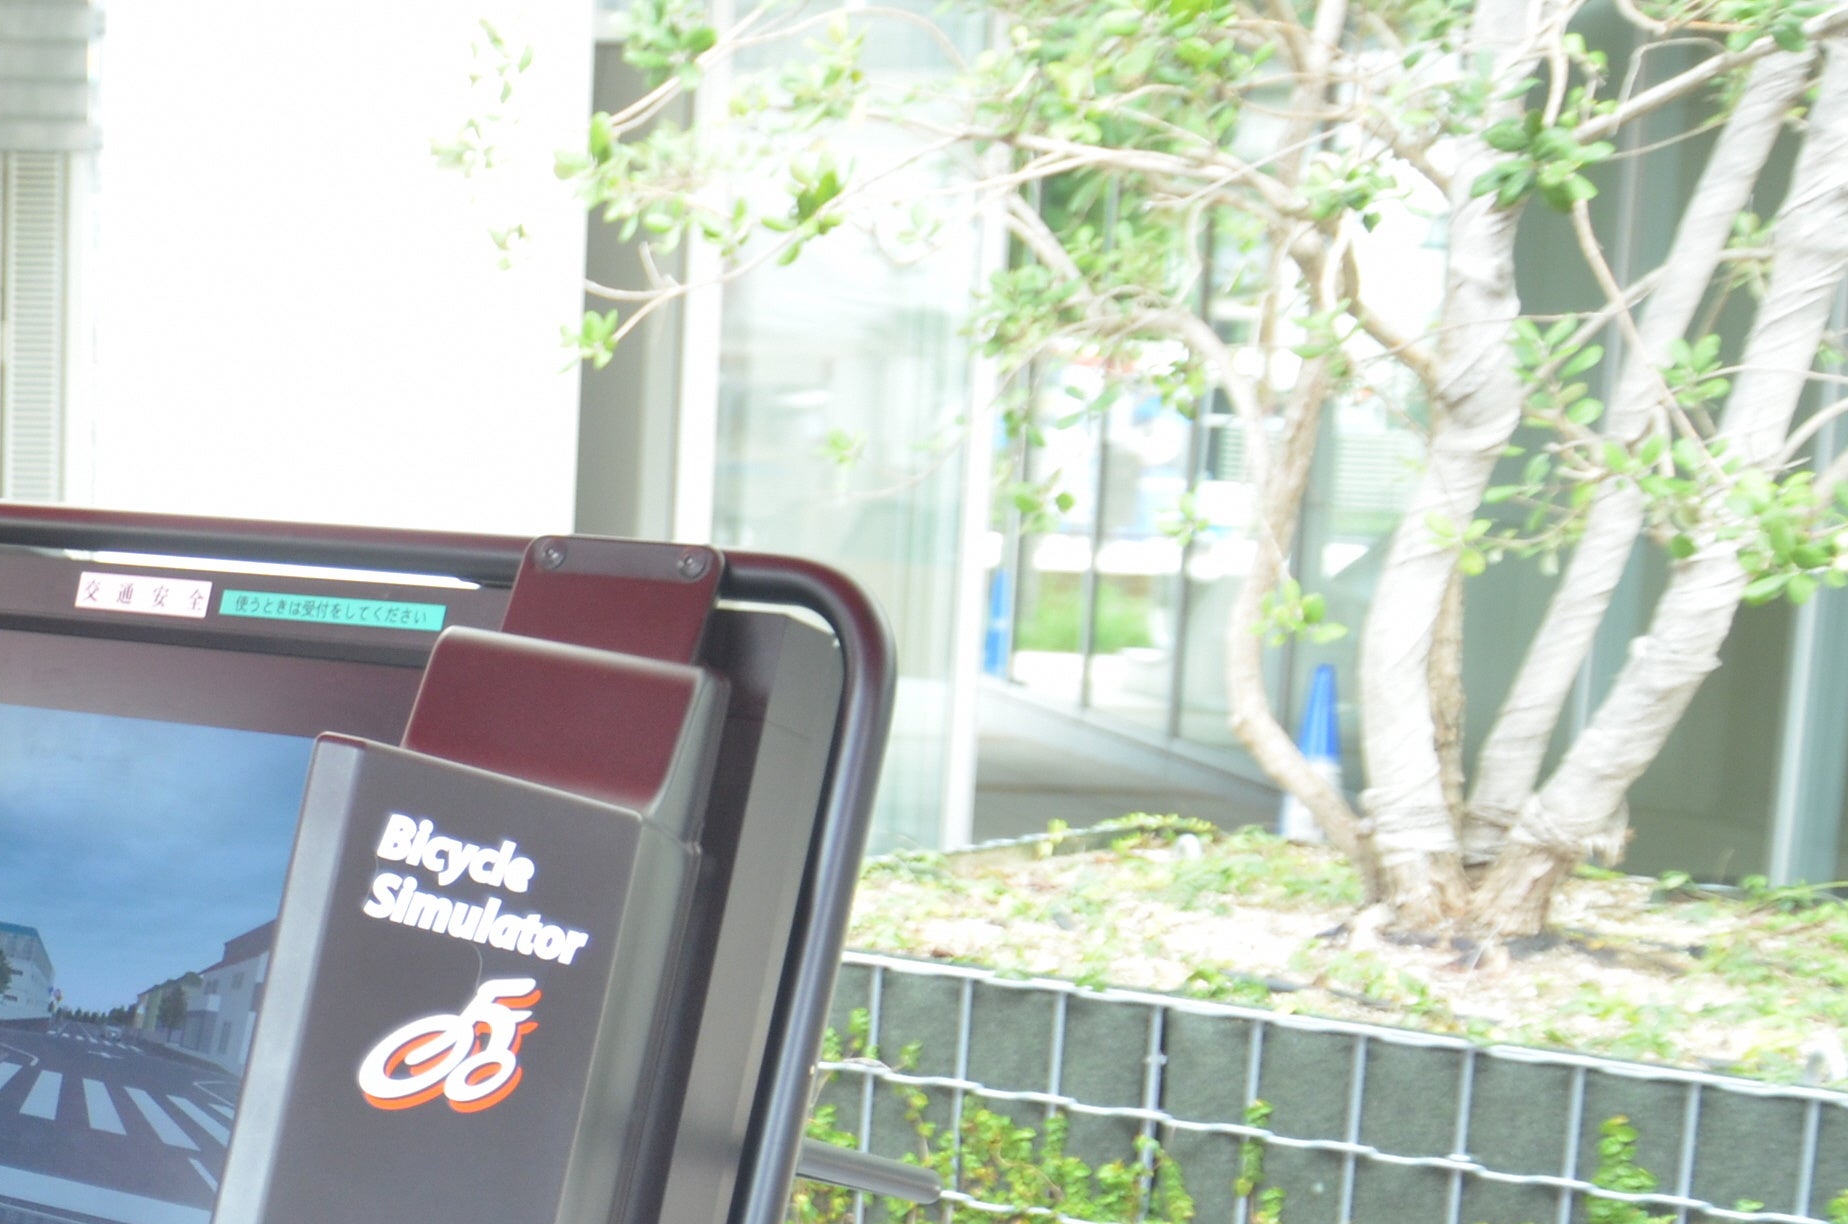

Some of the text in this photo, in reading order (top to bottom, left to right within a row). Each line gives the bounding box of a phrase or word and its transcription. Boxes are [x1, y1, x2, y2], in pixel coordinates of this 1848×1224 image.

[82, 579, 205, 611] 交通安全
[234, 593, 427, 625] 使うときは受付をしてください
[376, 813, 536, 894] Bicycle
[363, 871, 590, 966] Simulator
